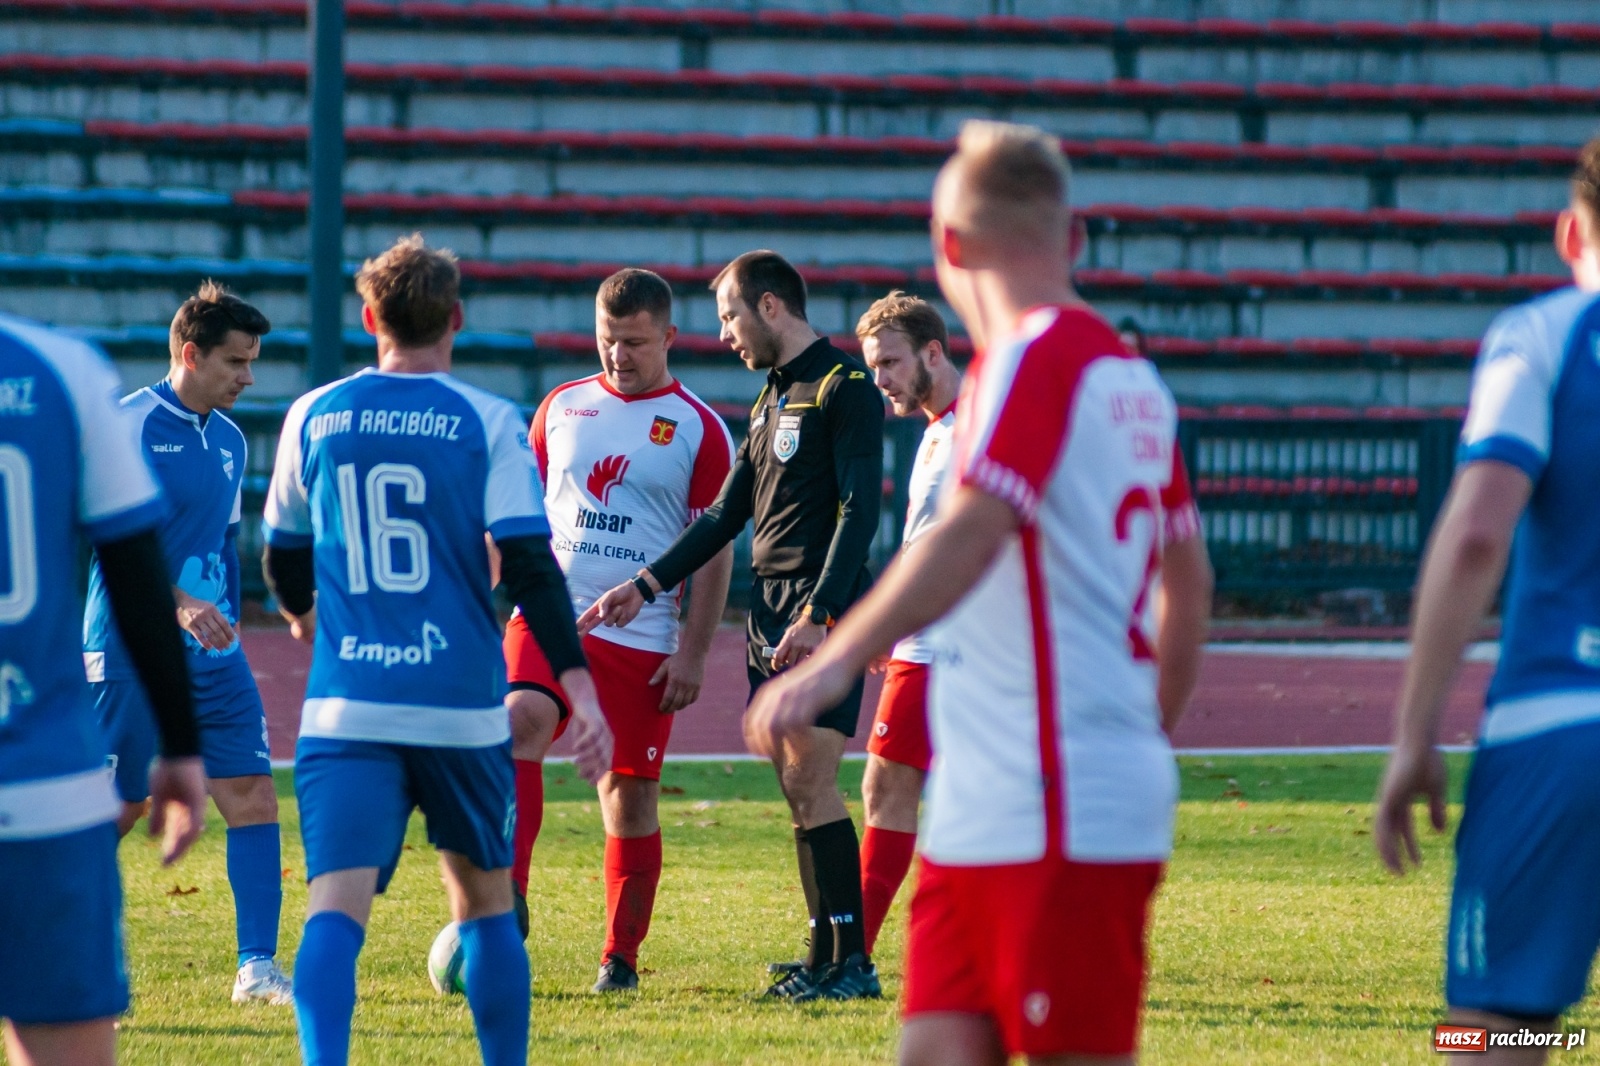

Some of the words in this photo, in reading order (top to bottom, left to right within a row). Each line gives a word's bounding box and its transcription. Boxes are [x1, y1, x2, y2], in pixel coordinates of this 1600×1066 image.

[309, 410, 353, 442] UNIA
[359, 407, 461, 441] RACIBÓRZ
[152, 444, 184, 452] saller
[337, 463, 430, 594] 16
[575, 508, 633, 534] Husar
[555, 541, 600, 556] GALERIA
[604, 545, 646, 563] CIEPŁA
